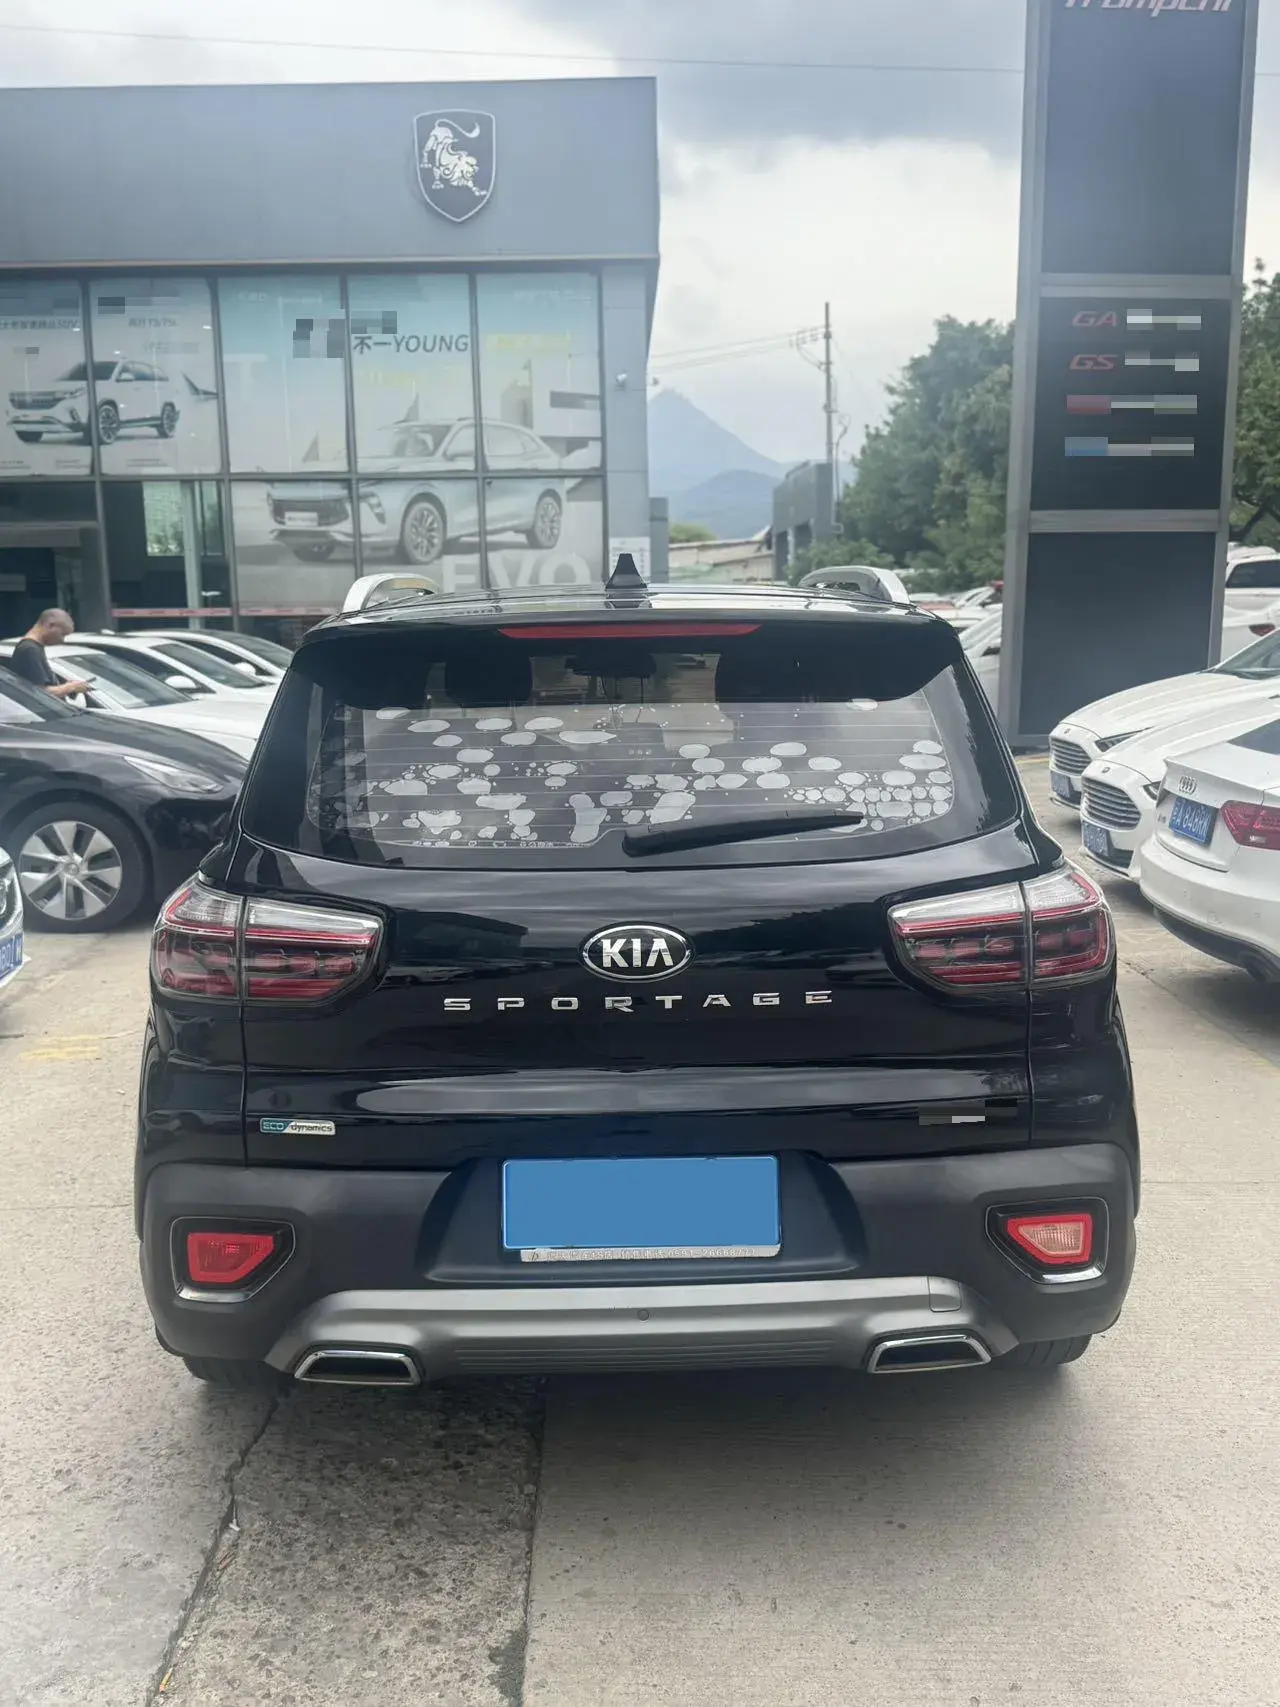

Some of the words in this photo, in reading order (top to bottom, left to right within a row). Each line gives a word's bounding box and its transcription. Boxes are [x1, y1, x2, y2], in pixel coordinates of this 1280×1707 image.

[1072, 310, 1117, 327] GA
[1069, 354, 1118, 370] GS
[602, 938, 673, 967] KIA
[444, 991, 831, 1012] SPORTAGE
